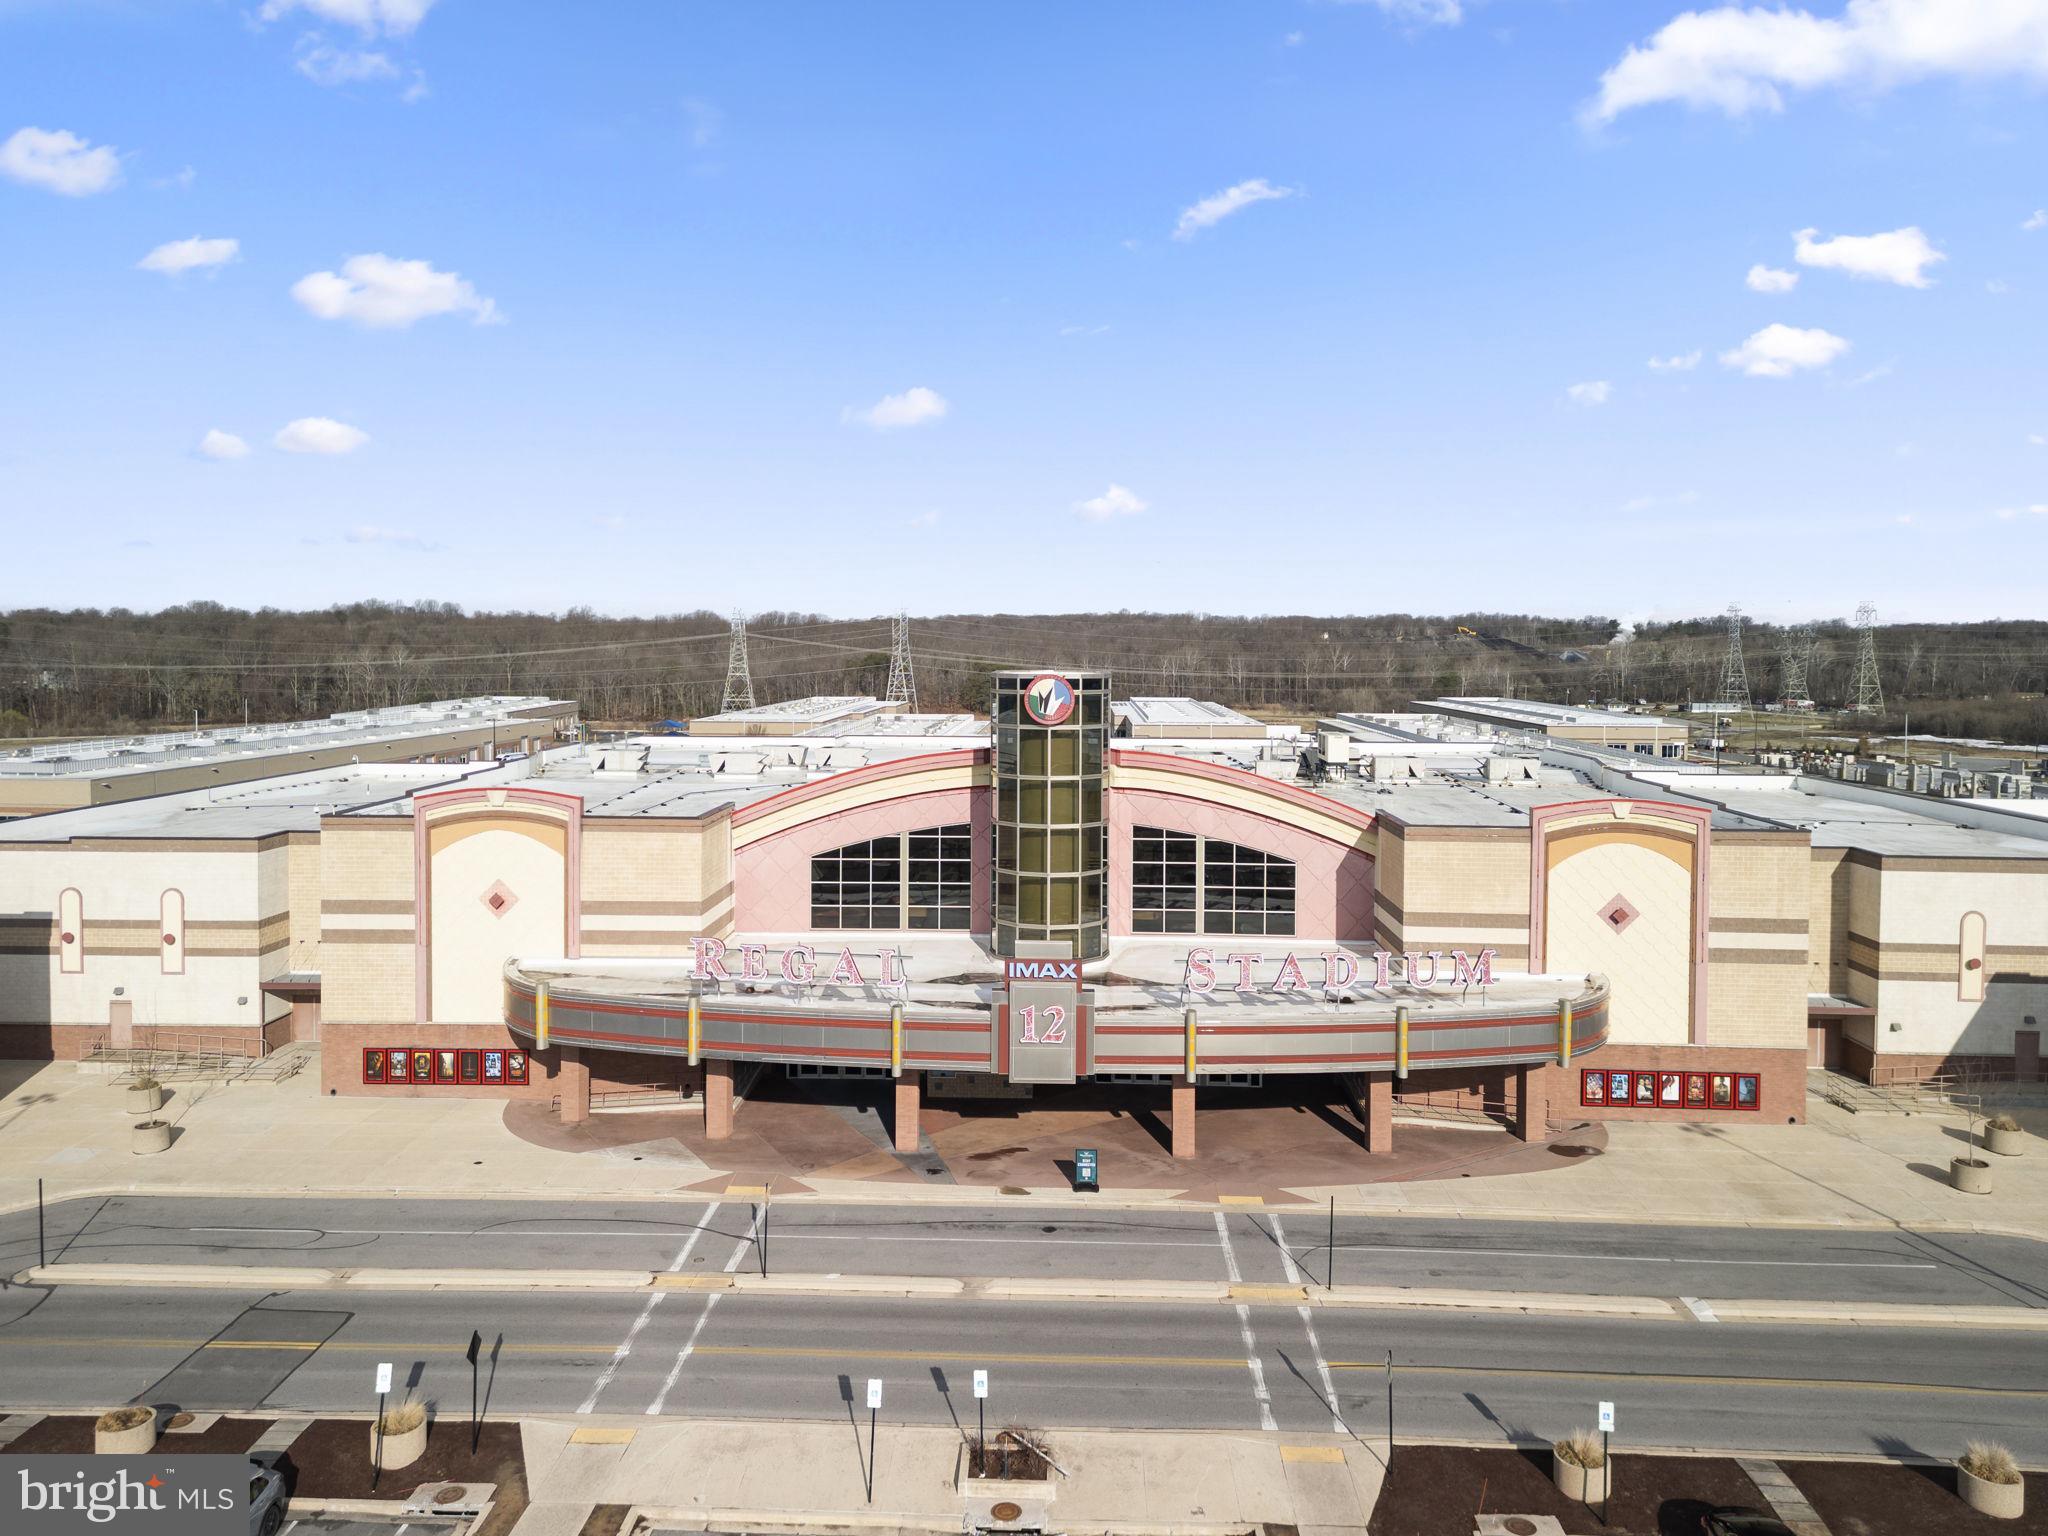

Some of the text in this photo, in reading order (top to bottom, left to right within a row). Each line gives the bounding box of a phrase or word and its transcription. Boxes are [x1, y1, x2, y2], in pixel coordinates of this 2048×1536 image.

[690, 937, 1497, 993] REGAL STADIUM
[1008, 962, 1078, 979] IMAX
[1019, 1004, 1067, 1044] 12
